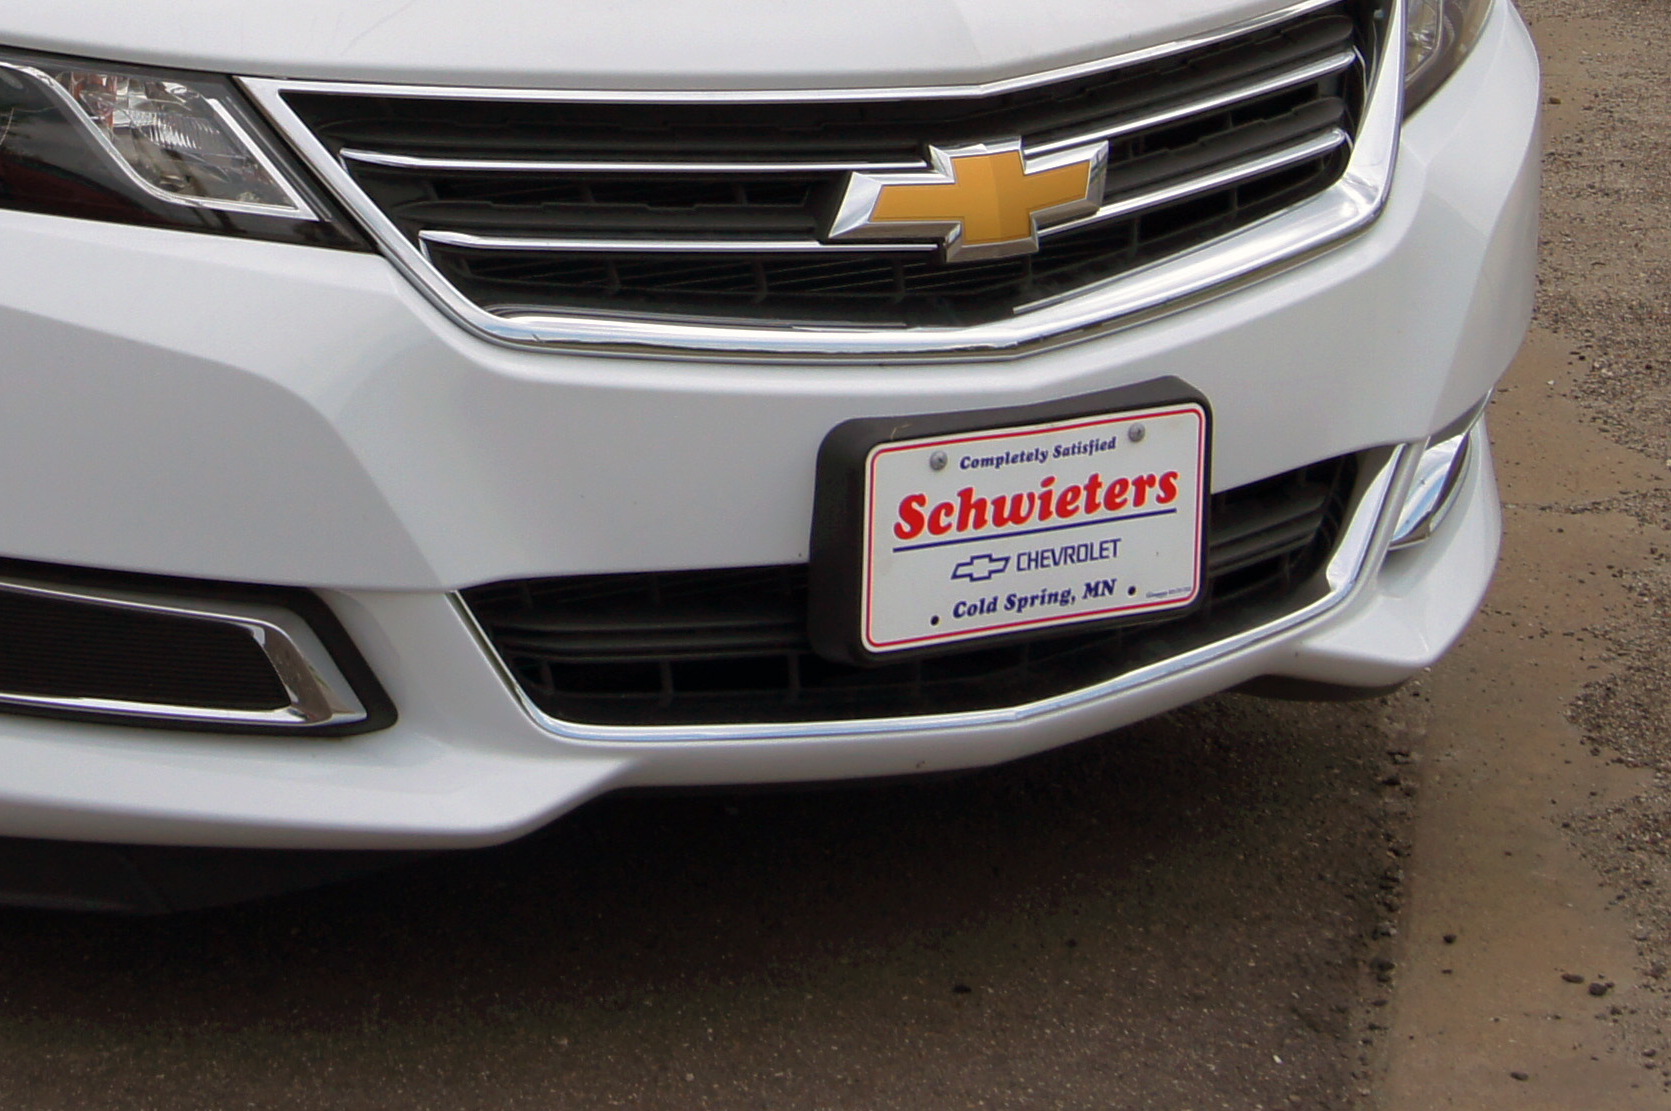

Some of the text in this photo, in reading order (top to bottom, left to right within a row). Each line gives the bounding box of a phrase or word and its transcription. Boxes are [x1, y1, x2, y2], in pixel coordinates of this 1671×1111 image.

[959, 436, 1117, 470] Completely Satisfied
[892, 470, 1179, 541] Schwieters
[1015, 537, 1122, 573] CHEVROLET
[952, 578, 1117, 619] Cold Spring, MN
